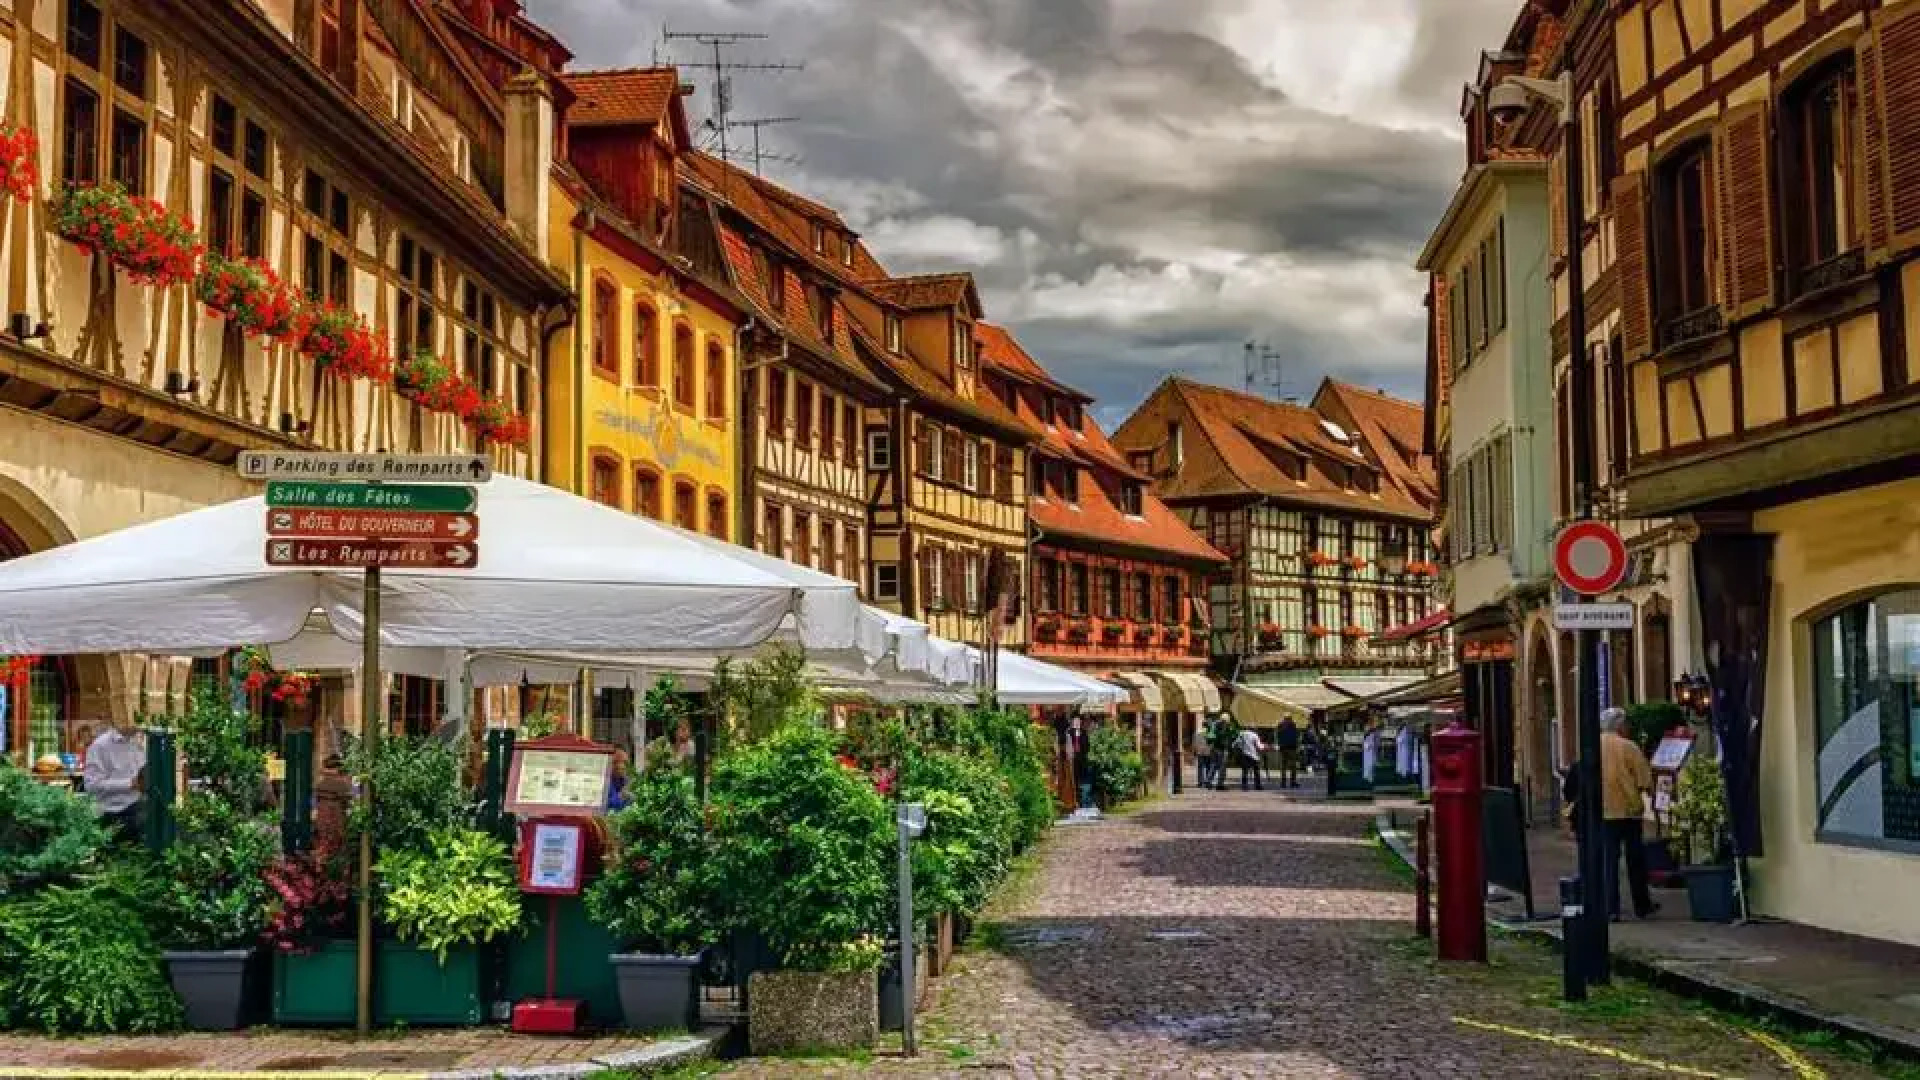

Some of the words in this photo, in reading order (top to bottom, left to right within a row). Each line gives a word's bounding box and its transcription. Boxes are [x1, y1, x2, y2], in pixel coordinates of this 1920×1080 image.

[273, 457, 339, 474] Parking
[345, 458, 375, 473] des
[383, 459, 464, 476] Remparts
[273, 487, 317, 502] Salle
[325, 488, 354, 503] des
[365, 488, 411, 505] Fêtes
[299, 511, 334, 529] HÔTEL
[339, 516, 357, 530] DU
[361, 517, 435, 533] GOUVERNEUR
[297, 546, 328, 561] Les
[340, 546, 427, 564] Remparts
